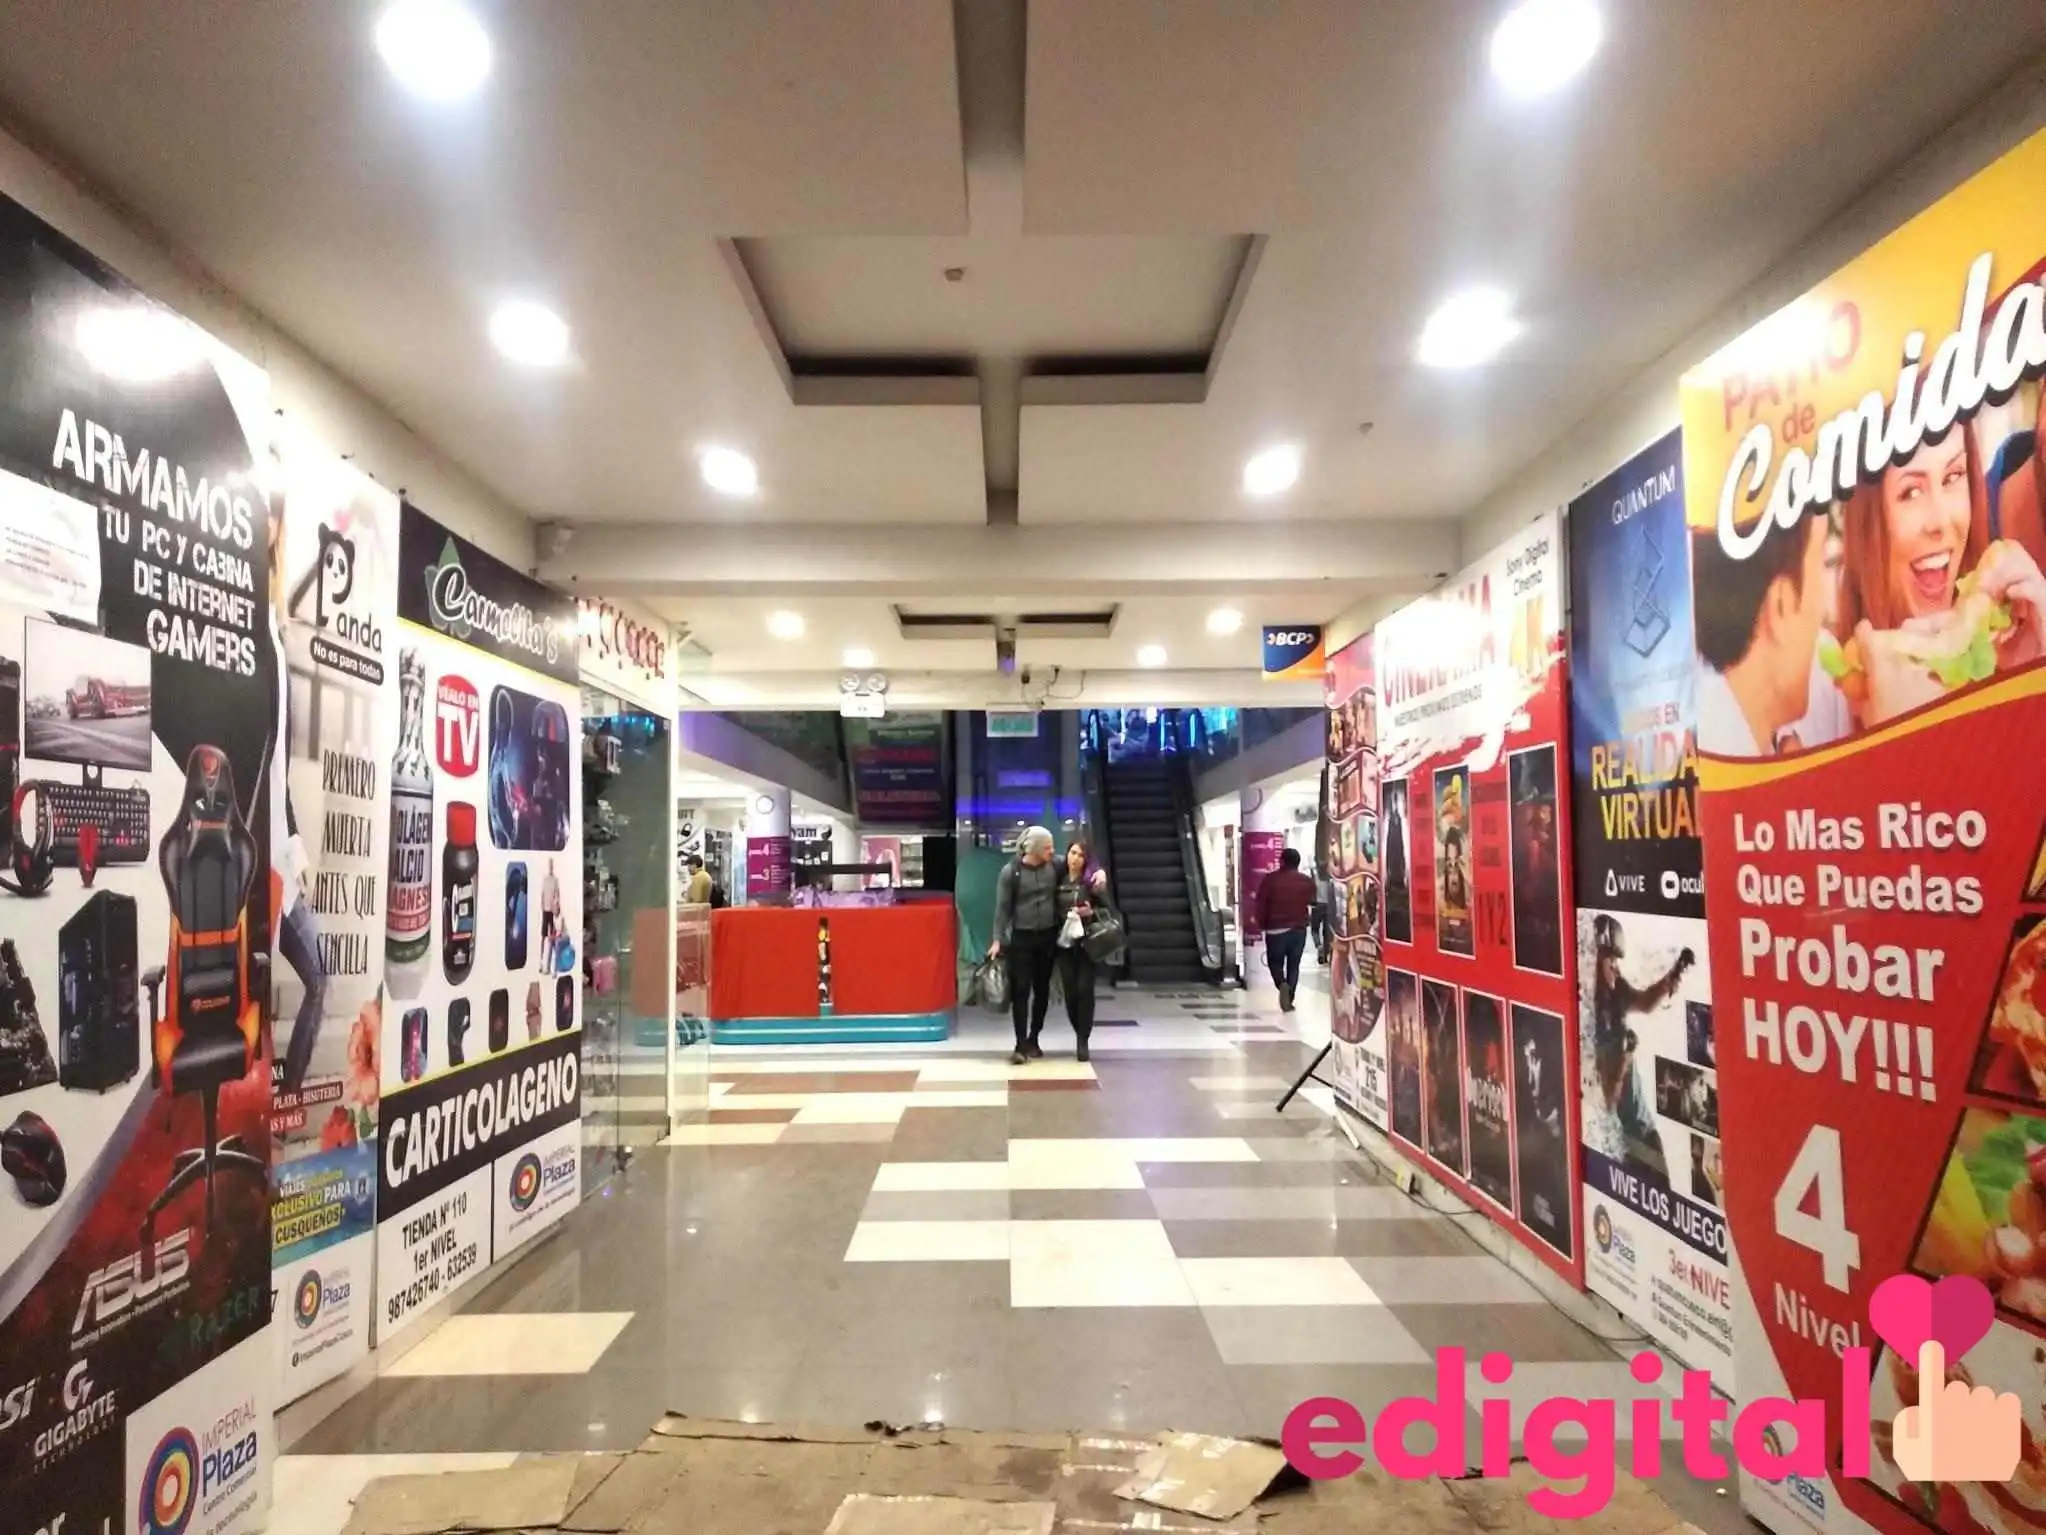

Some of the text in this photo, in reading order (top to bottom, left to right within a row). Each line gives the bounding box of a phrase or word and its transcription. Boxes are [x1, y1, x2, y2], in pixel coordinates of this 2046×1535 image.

[1782, 402, 1817, 445] de
[52, 408, 254, 550] ARMAMOS
[1612, 465, 1676, 526] QUANTUM
[102, 504, 131, 544] TU
[142, 519, 169, 560] PC
[192, 542, 255, 593] CABINA
[134, 559, 256, 632] DE INTERNET
[146, 607, 256, 678] GAMERS
[313, 641, 327, 659] No
[328, 649, 338, 663] es
[1275, 631, 1308, 647] BCP
[438, 700, 480, 766] TV
[320, 809, 372, 858] MUERTA
[1734, 801, 1988, 852] Lo Mas Rico
[311, 871, 376, 920] ANTES QUE
[1617, 874, 1646, 893] VIVE
[1736, 863, 1984, 915] Que Puedas
[316, 932, 368, 976] SENCILLA
[1740, 917, 1945, 1002] Probar
[1743, 996, 1937, 1103] HOY!!!
[385, 1051, 578, 1189] CARTICOLAGENO
[324, 1179, 351, 1203] PARA
[543, 1158, 576, 1187] Plaza
[402, 1206, 439, 1250] TIENDA
[451, 1190, 468, 1220] 110
[1608, 1164, 1639, 1203] VIVE
[1641, 1182, 1670, 1222] LOS
[1672, 1203, 1729, 1254] JUEGO
[1774, 1123, 1861, 1294] 4
[71, 1228, 191, 1335] ASUS
[413, 1227, 458, 1275] 1er NIVEL
[322, 1282, 351, 1310] Plaza
[388, 1265, 440, 1324] 987426740
[446, 1241, 478, 1282] 632539
[1690, 1263, 1731, 1311] NIVE
[1774, 1281, 1861, 1360] Nivel
[33, 1389, 118, 1458] GIGABYTE
[201, 1394, 257, 1458] IMPERIAL
[202, 1429, 257, 1498] Plaza
